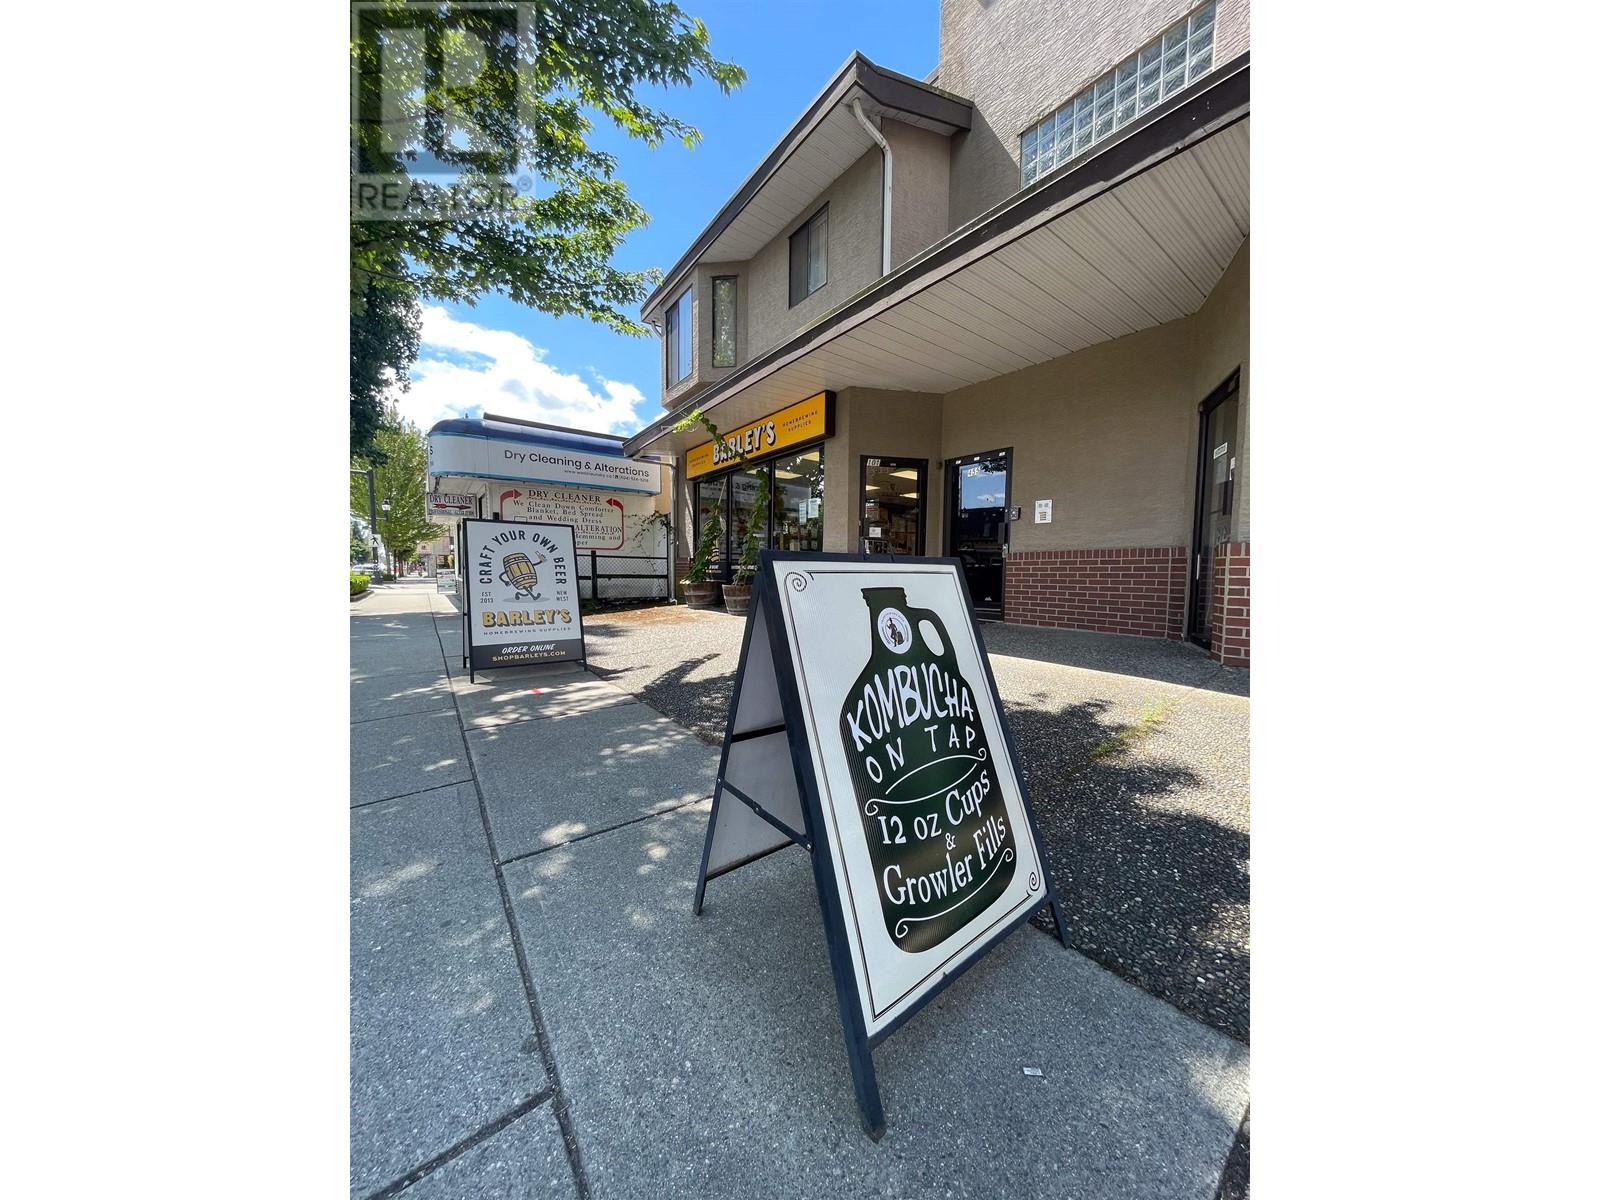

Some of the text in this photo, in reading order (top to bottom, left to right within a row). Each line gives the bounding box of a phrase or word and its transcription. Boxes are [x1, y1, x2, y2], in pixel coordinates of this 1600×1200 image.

[713, 419, 776, 465] BARLEY'S
[504, 450, 649, 478] Dry Cleaning & Alterations
[867, 458, 881, 467] 101
[429, 494, 473, 505] DRY CLEANER
[528, 489, 601, 503] DRY CLEANER
[528, 501, 551, 509] Clean
[555, 502, 576, 511] Down
[546, 514, 579, 524] Wedding
[582, 516, 602, 524] Dress
[580, 510, 604, 519] Spread
[575, 524, 622, 534] ALTERATION
[479, 530, 567, 585] CRAFT YOUR OWN BEER
[482, 609, 572, 627] BARLEY'S
[492, 650, 566, 662] SHOPBARLEYS.COM
[501, 643, 556, 655] ORDER ONLINE
[845, 662, 975, 752] KOMBUCHA
[866, 723, 977, 784] ON TAP
[878, 768, 992, 846] 12 oz Cups
[945, 832, 957, 850] &
[883, 817, 1007, 906] Growler Fills
